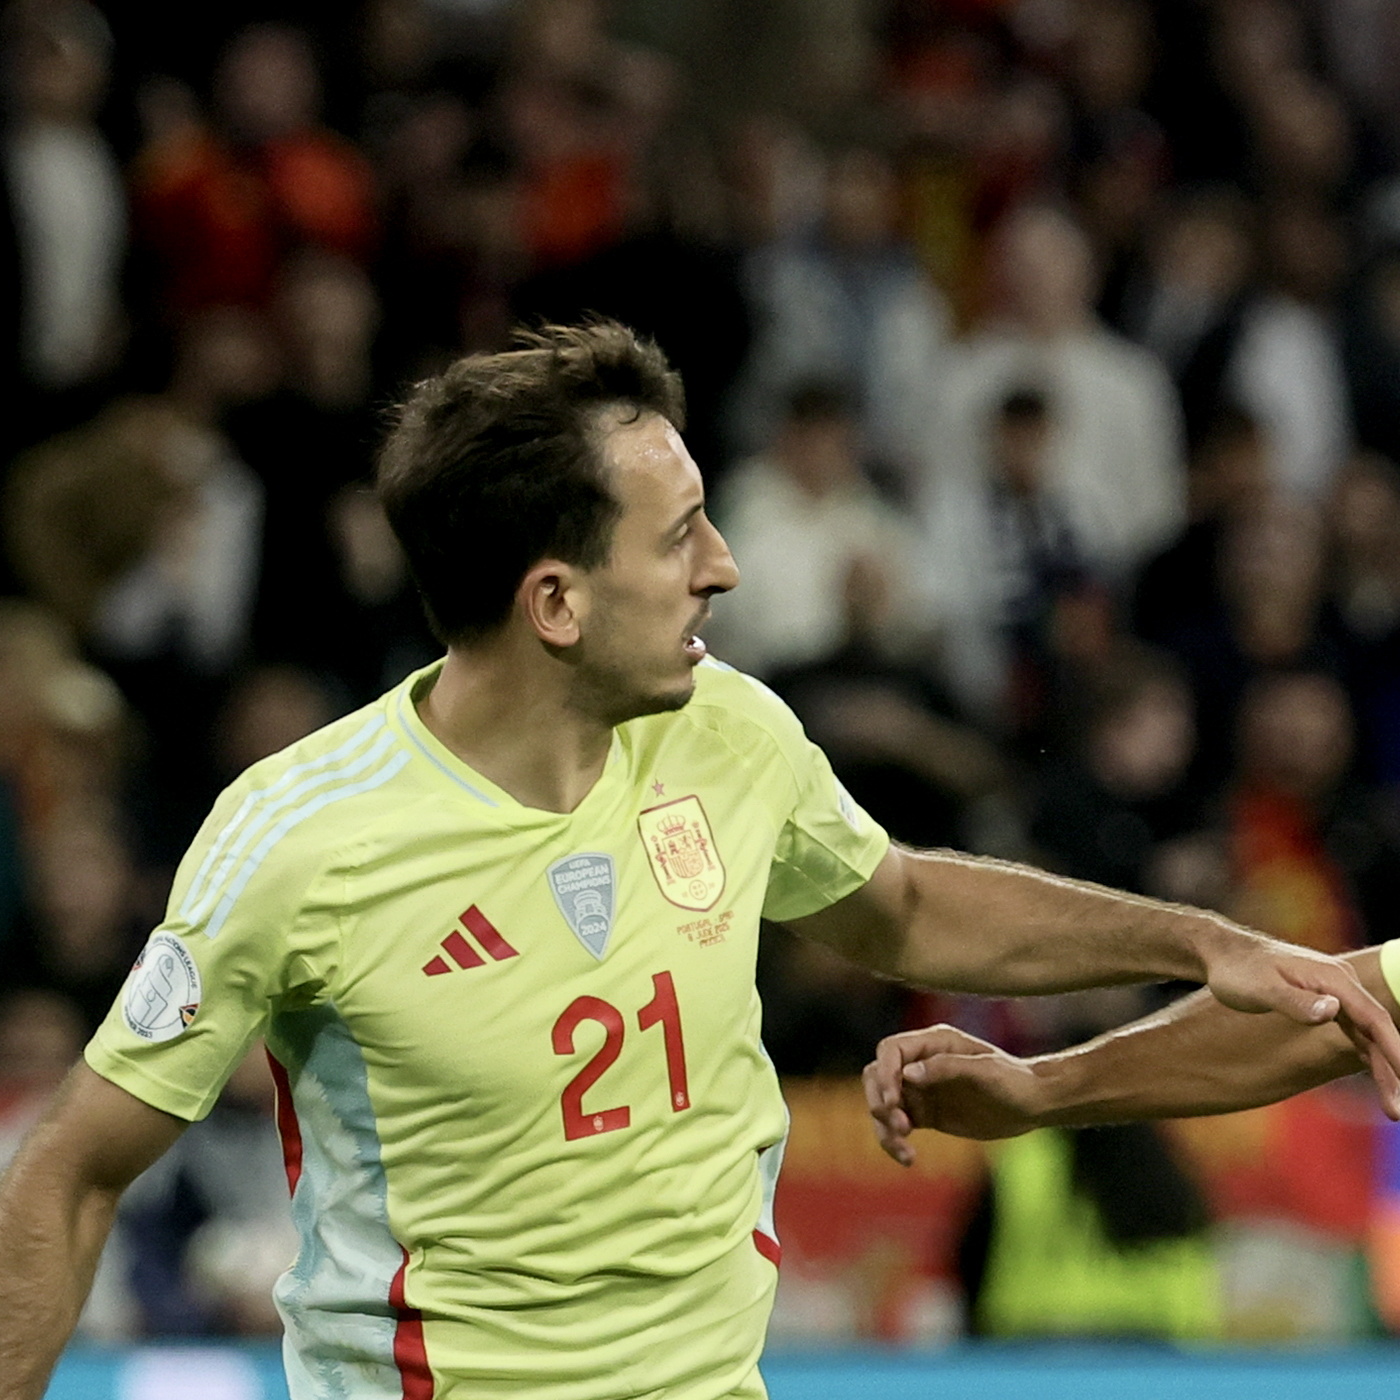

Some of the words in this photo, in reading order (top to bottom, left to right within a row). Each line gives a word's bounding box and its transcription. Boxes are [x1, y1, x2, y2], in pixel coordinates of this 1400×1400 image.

[554, 863, 609, 885] EUROPEAN
[557, 874, 611, 895] CHAMPIONS
[580, 921, 607, 936] 2024
[551, 970, 691, 1142] 21
